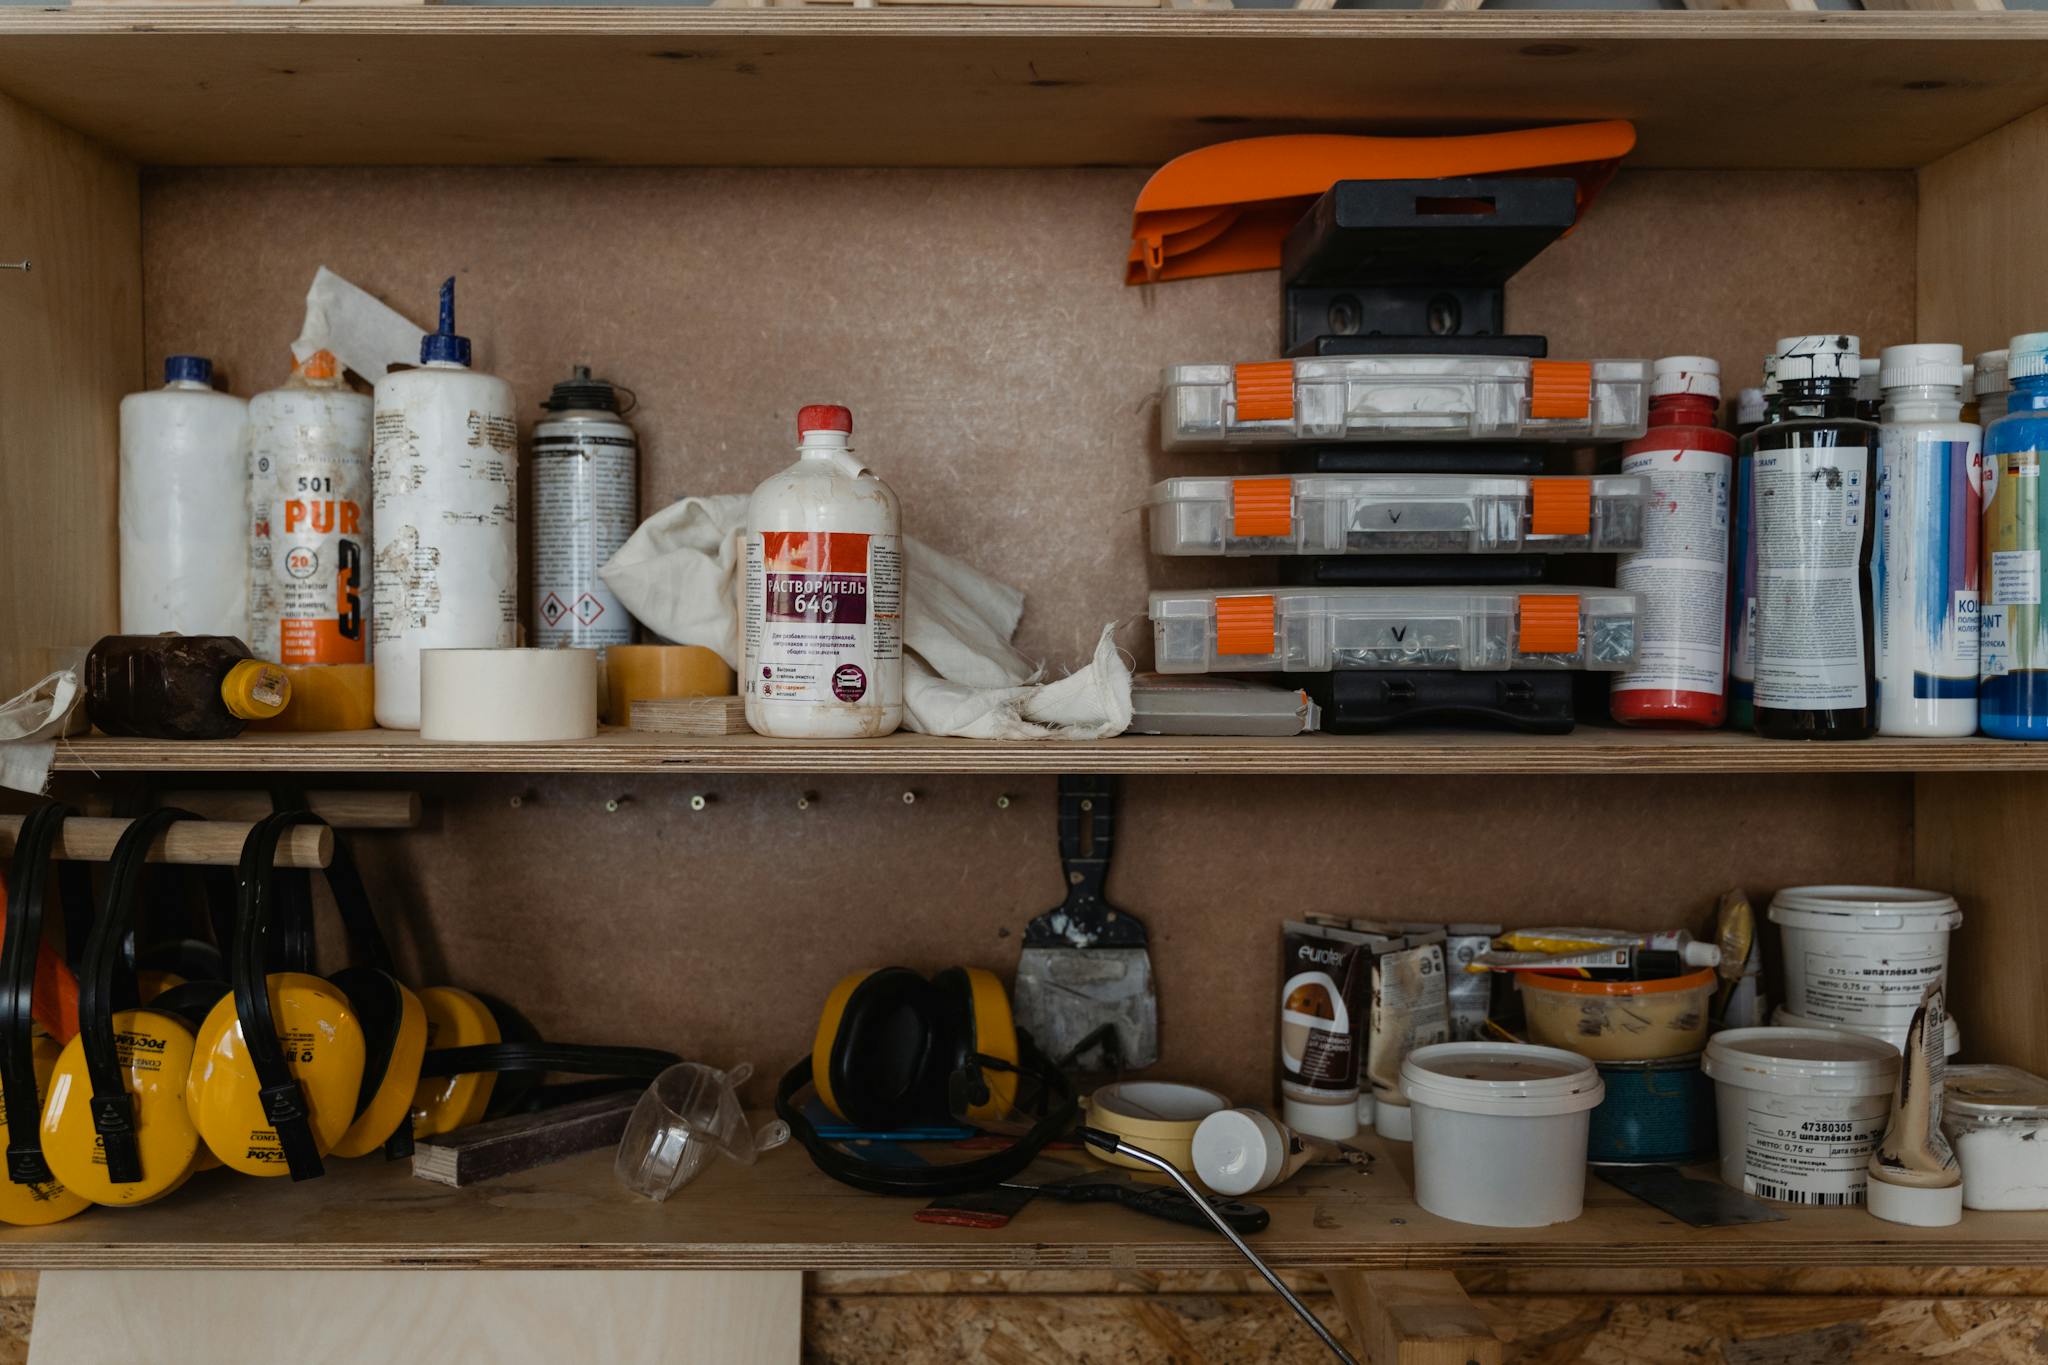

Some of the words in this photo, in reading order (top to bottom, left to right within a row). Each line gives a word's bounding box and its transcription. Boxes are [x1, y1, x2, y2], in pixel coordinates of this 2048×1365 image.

[298, 477, 331, 492] 501
[285, 500, 360, 534] PUR
[291, 556, 309, 567] 20
[768, 580, 865, 595] РАСТВОРИТЕЛЬ
[795, 595, 833, 613] 646
[1297, 945, 1344, 967] eurotex
[1862, 967, 1918, 976] шпатлёвка
[1801, 1122, 1853, 1132] 47380305
[1778, 1129, 1797, 1139] 0.75
[1800, 1134, 1851, 1142] шпатлёвка
[1756, 1139, 1782, 1150] нетто:
[1784, 1143, 1803, 1153] 0,75
[1831, 1147, 1848, 1155] дата
